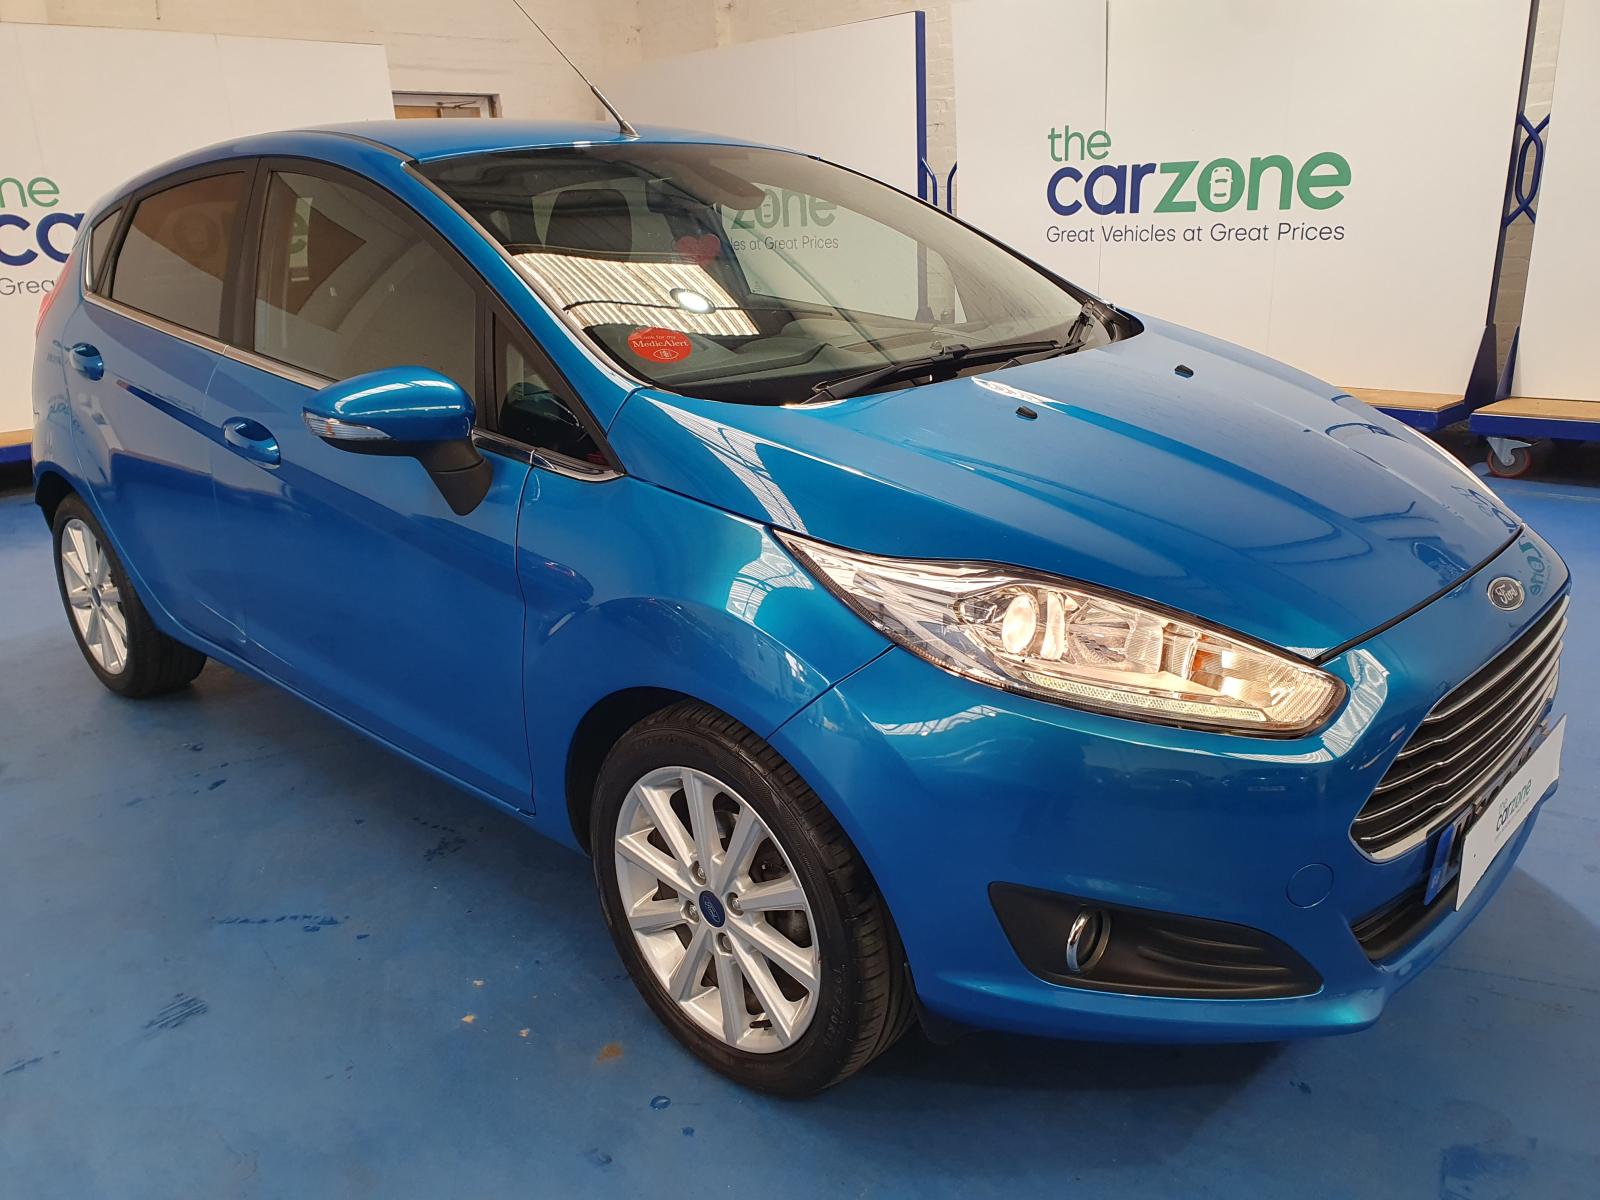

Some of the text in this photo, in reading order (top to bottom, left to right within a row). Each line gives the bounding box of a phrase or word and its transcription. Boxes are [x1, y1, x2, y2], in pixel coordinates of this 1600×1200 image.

[1047, 125, 1112, 162] the
[1046, 151, 1352, 217] carzone
[1046, 222, 1345, 242] Great Vehicles at Great Prices
[749, 240, 761, 251] at
[764, 236, 799, 250] Great
[802, 236, 839, 249] Prices
[632, 340, 688, 348] MedicAlert
